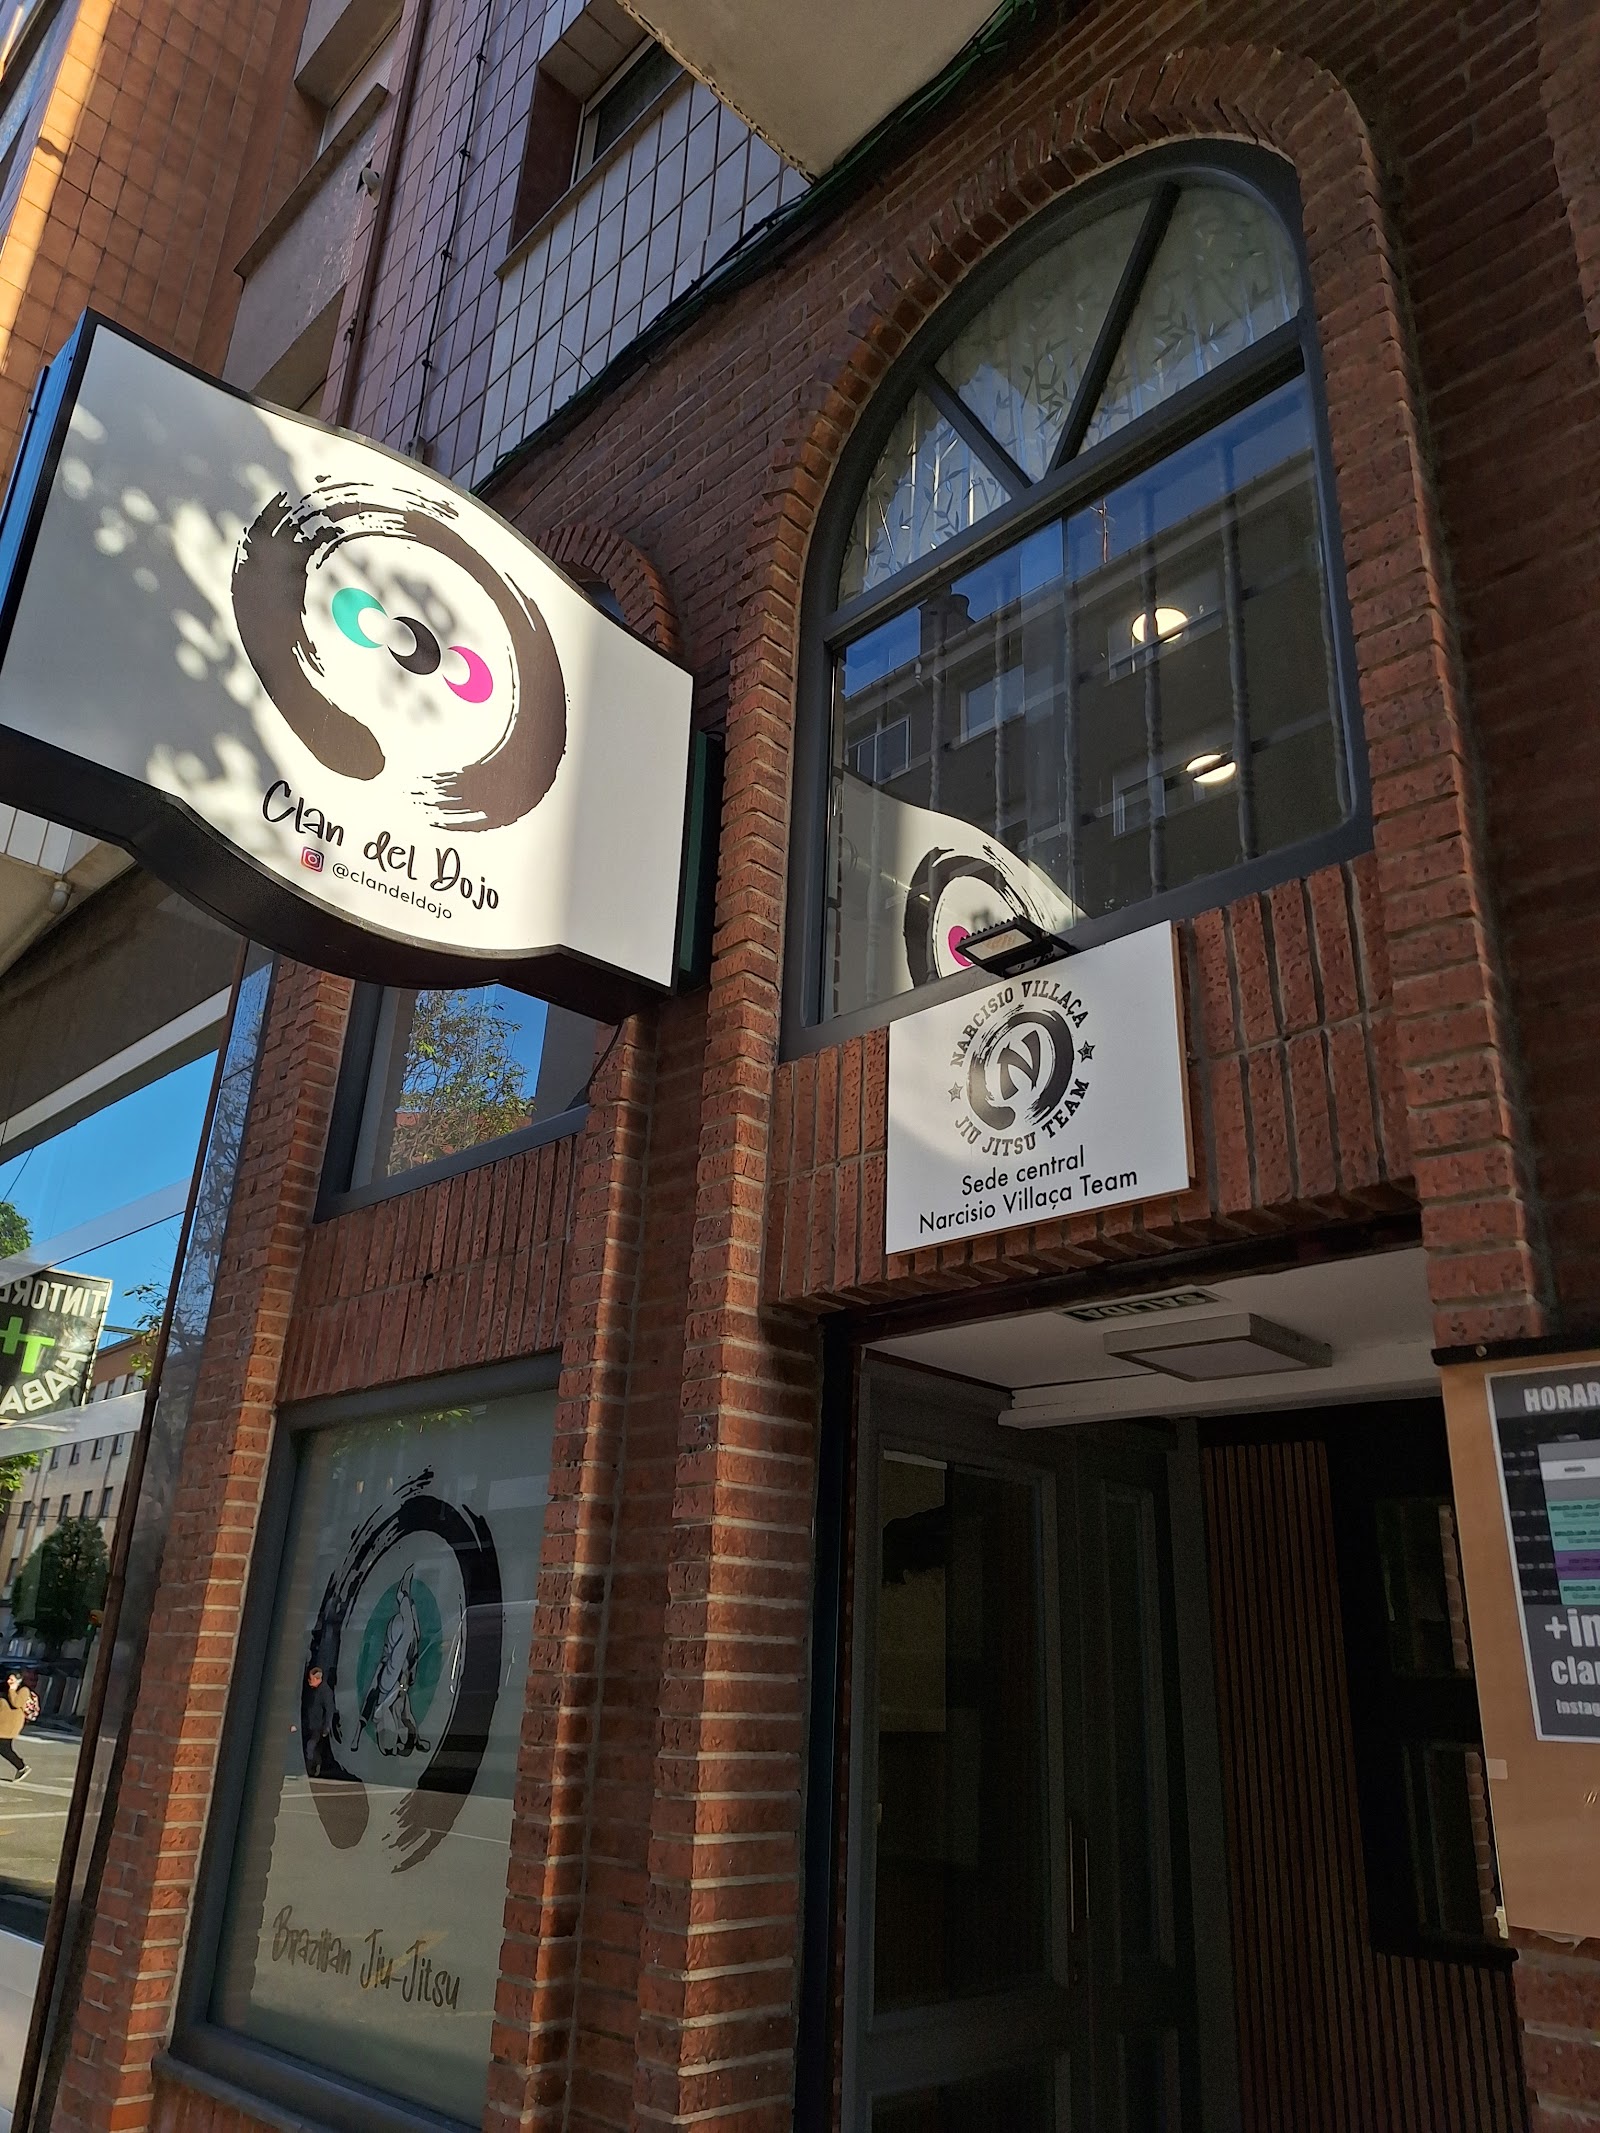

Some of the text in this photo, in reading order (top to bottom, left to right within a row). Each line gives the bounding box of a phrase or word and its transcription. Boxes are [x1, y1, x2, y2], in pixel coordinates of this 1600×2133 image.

[262, 779, 499, 910] Clan del Dojo
[332, 862, 452, 919] @clandeldojo
[950, 980, 1089, 1067] NARCISIO VILLAÇA
[955, 1079, 1089, 1156] JIU JITSU TEAM
[919, 1170, 1138, 1234] Narcisio Villaça Team
[961, 1144, 1085, 1196] Sede central
[1073, 1294, 1206, 1318] SALIDA
[272, 1905, 460, 2010] Brazilian Jiu-Jitsu
